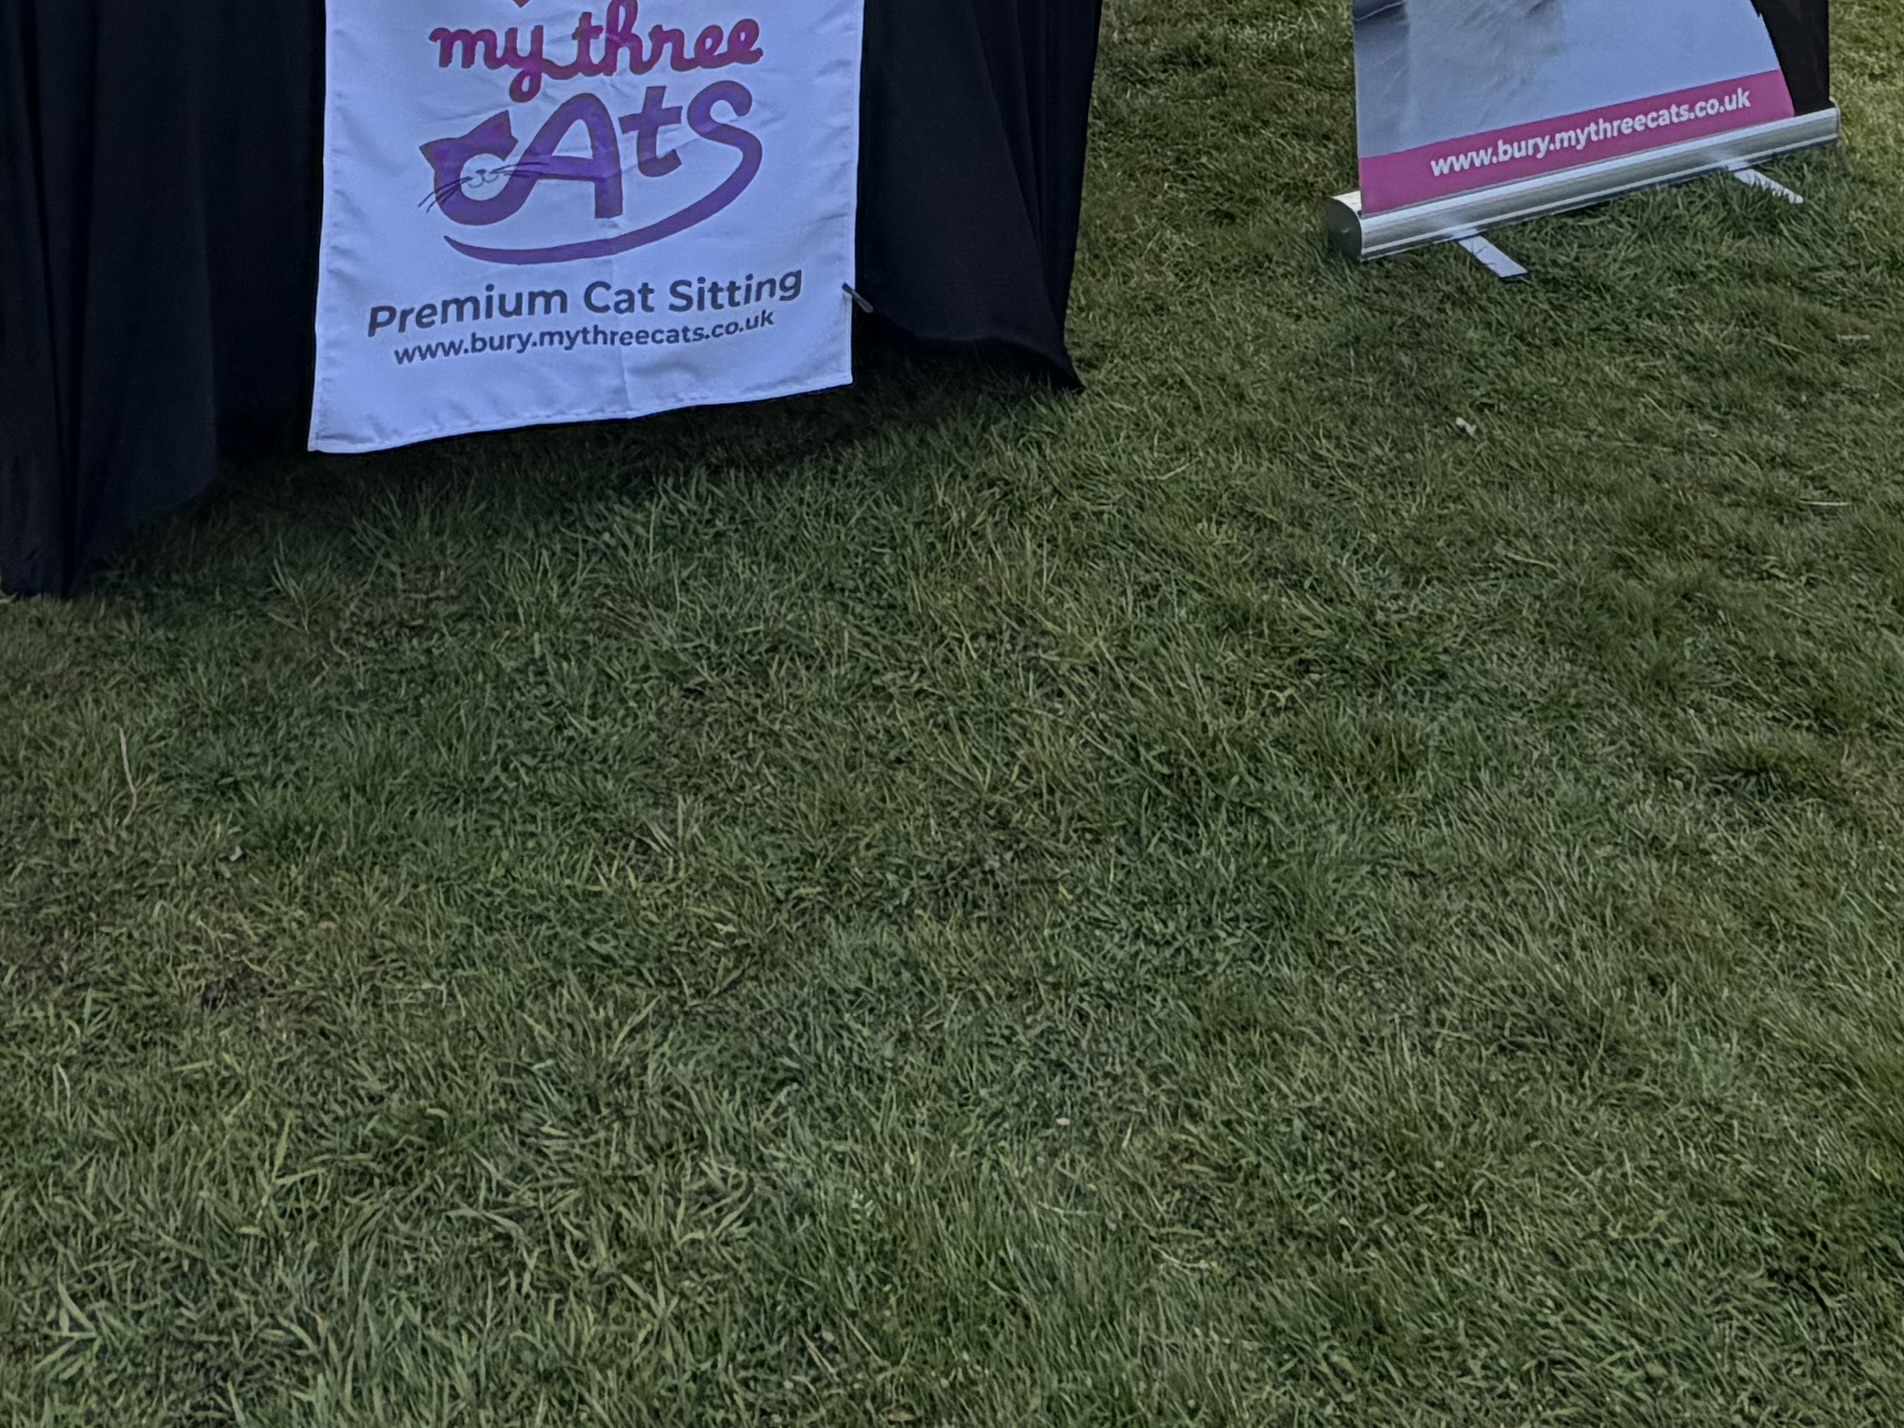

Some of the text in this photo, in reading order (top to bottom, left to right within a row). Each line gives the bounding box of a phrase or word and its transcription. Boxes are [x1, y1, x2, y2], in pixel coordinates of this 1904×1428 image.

[1430, 87, 1751, 178] www.bury.mythreecats.co.uk
[367, 268, 803, 339] Premium Cat Sitting
[394, 308, 775, 366] www.bury.mythreecats.co.uk
